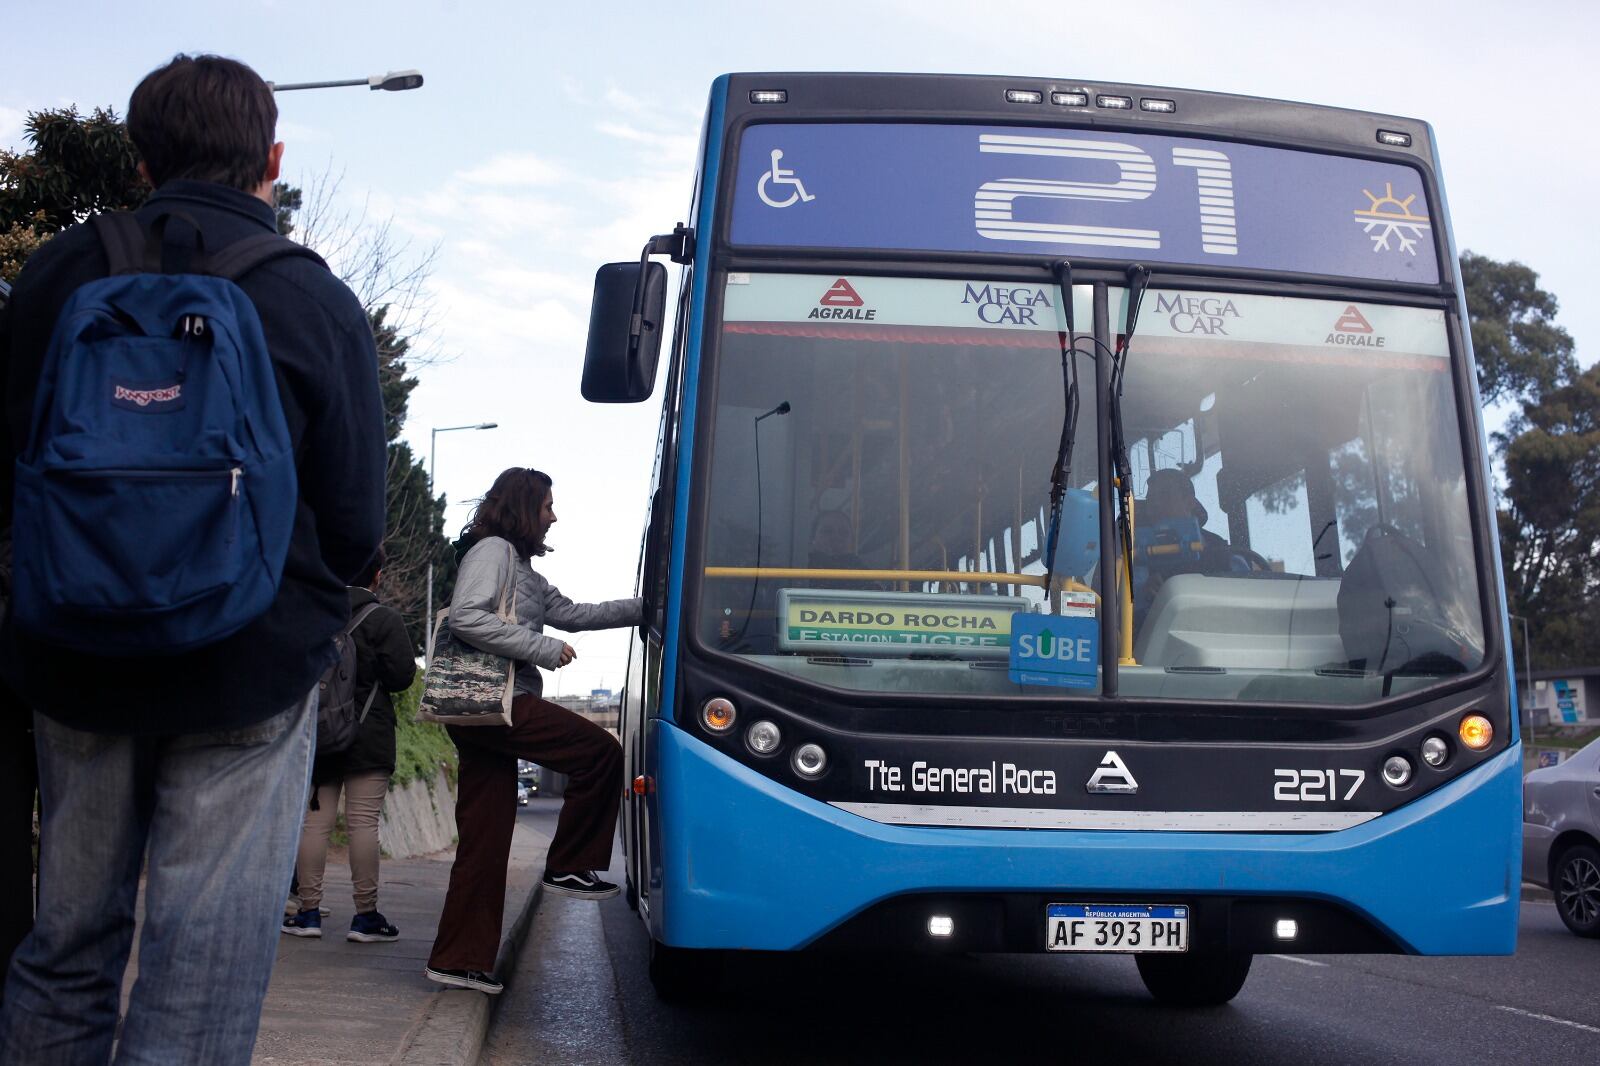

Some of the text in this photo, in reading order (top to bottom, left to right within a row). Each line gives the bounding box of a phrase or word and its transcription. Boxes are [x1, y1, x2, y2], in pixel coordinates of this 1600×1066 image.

[975, 134, 1238, 256] 21
[960, 282, 1054, 308] MEGA
[1153, 292, 1241, 318] MEGA
[808, 307, 877, 321] AGRALE
[977, 302, 1039, 326] CAR
[1169, 312, 1229, 336] CAR
[1324, 332, 1385, 348] AGRALE
[799, 610, 997, 630] DARDO ROCHA
[1018, 633, 1092, 662] SUBE
[864, 759, 1057, 795] Tte. General Roca
[1273, 768, 1366, 801] 2217
[1085, 910, 1117, 918] REPÚBLICA
[1054, 920, 1181, 946] AF 393 PH
